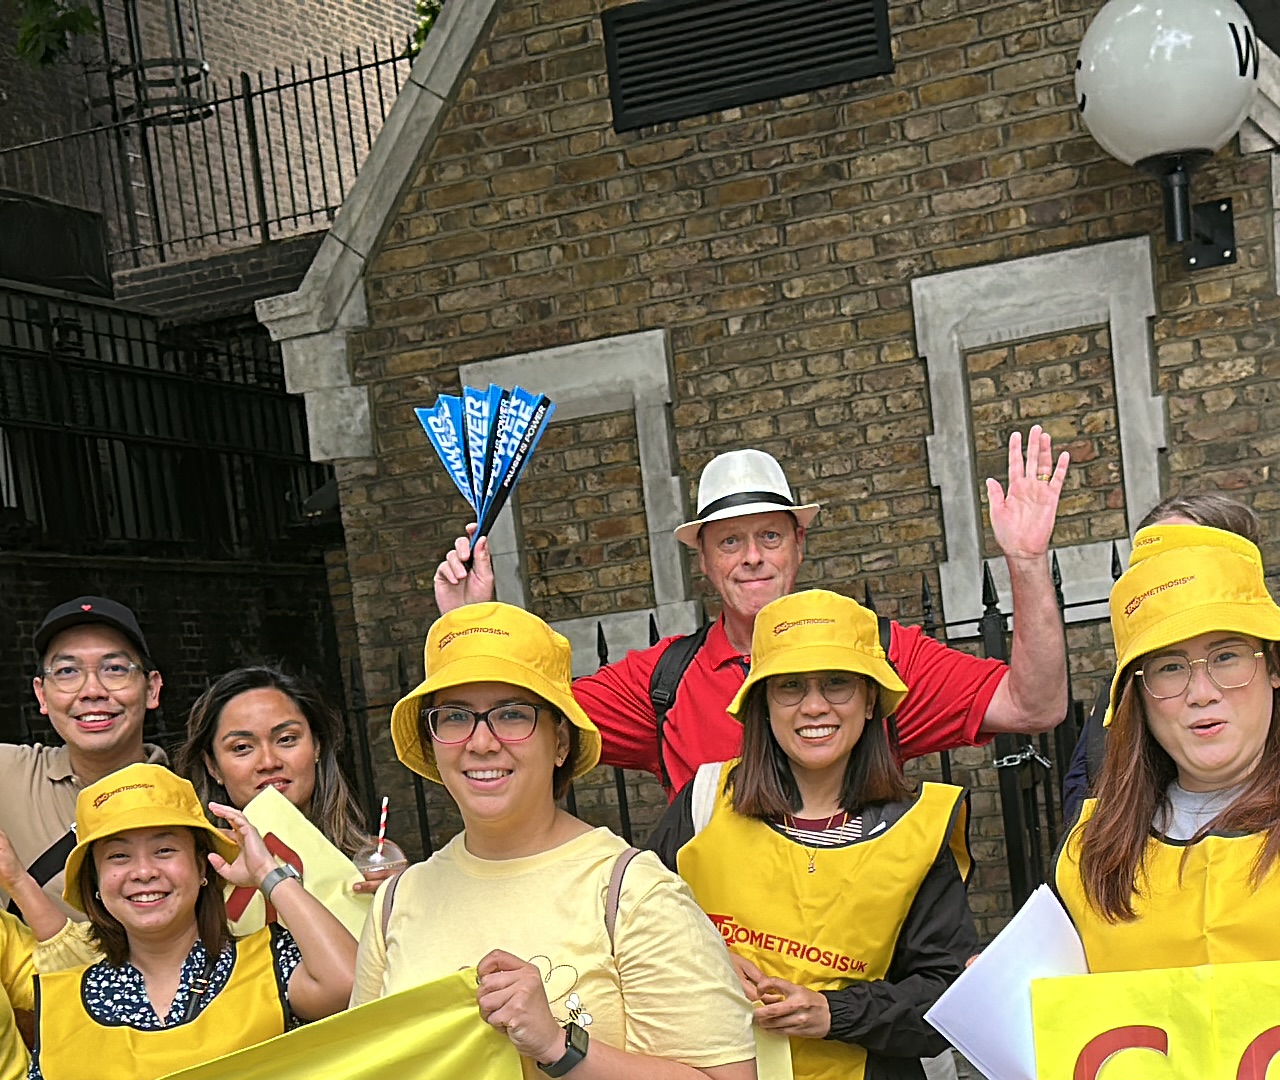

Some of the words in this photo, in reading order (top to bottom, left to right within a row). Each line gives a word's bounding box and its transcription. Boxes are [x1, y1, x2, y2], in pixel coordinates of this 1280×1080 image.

[465, 396, 485, 498] POWER
[503, 452, 522, 488] PAUSE
[520, 440, 527, 454] IS
[525, 405, 546, 443] POWER
[717, 923, 850, 972] DOMETRIOSIS
[850, 959, 867, 973] UK
